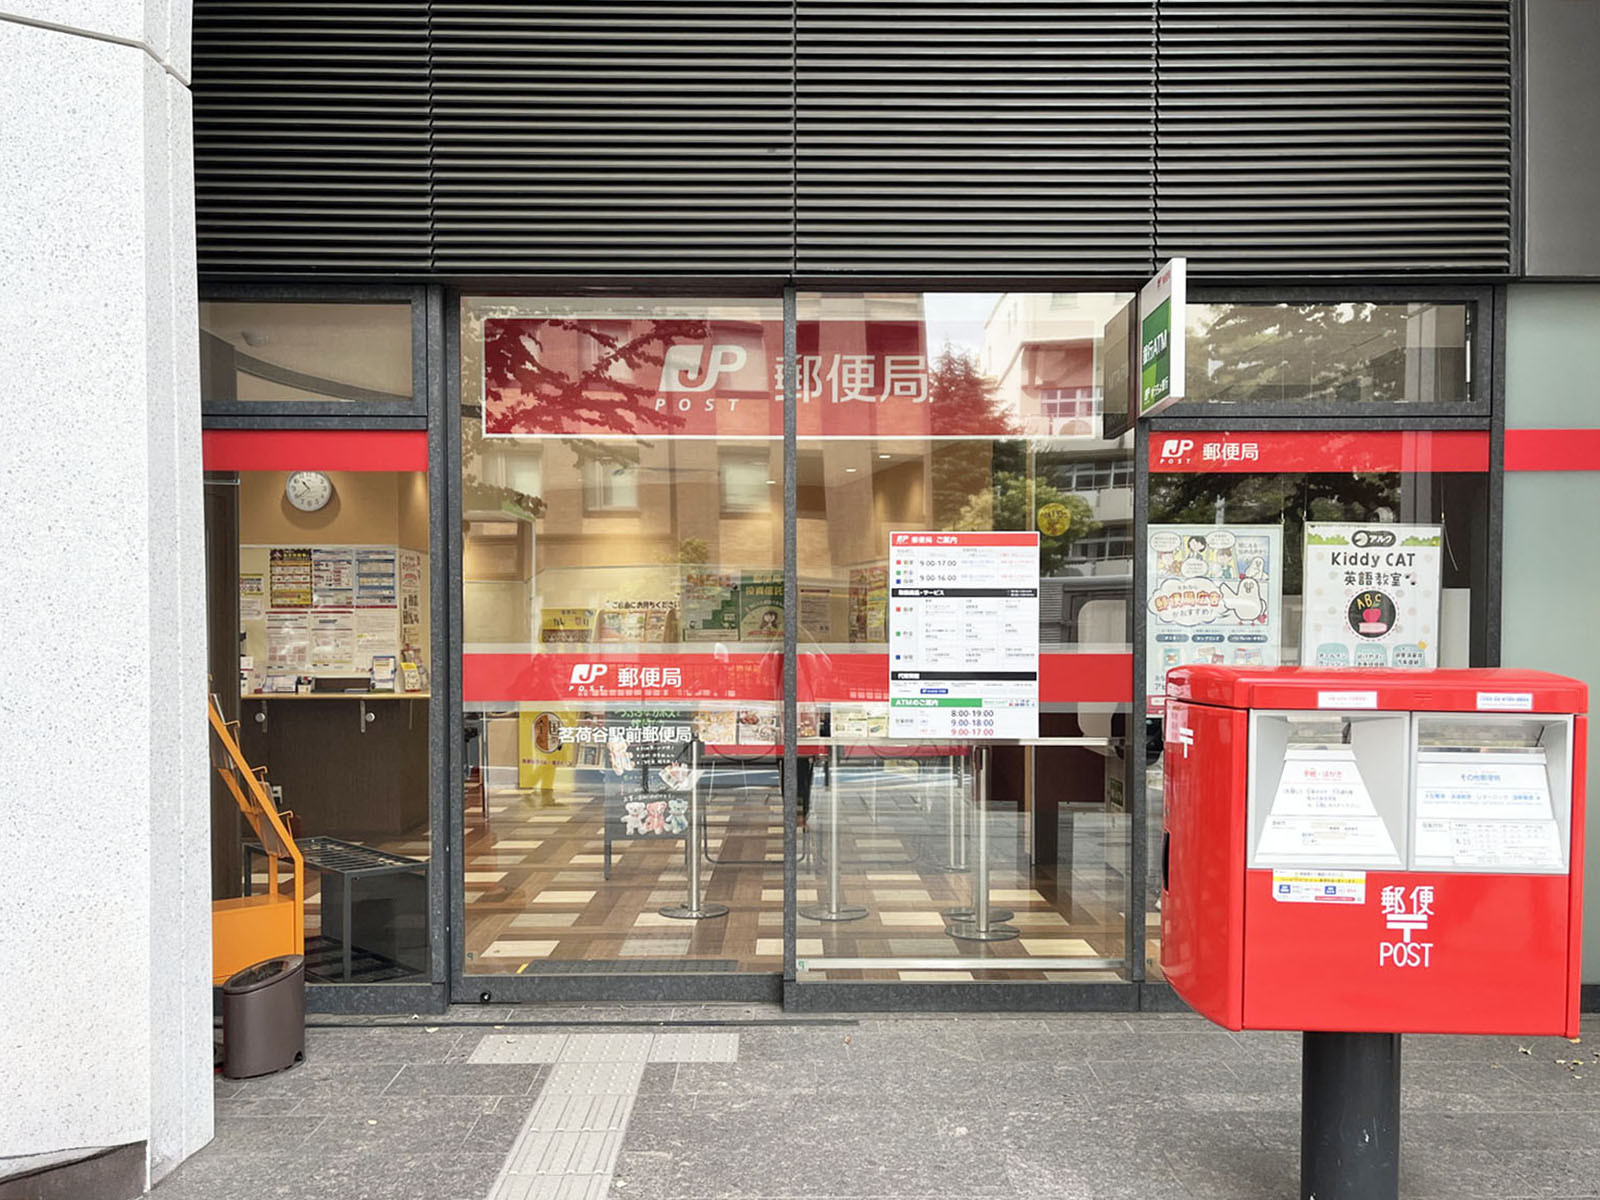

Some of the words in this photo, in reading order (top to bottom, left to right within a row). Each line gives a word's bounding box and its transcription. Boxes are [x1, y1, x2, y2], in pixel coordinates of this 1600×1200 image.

[775, 354, 930, 403] 郵便局
[655, 398, 739, 411] POST
[1202, 443, 1259, 461] 郵便局
[936, 536, 958, 544] ご案内
[1331, 552, 1380, 568] Kiddy
[1386, 553, 1416, 567] CAT
[1344, 571, 1402, 586] 英語教室
[617, 667, 682, 688] 郵便局
[558, 726, 692, 743] 茗荷谷駅前郵便局
[1380, 885, 1435, 915] 郵便
[1379, 943, 1434, 968] POST
